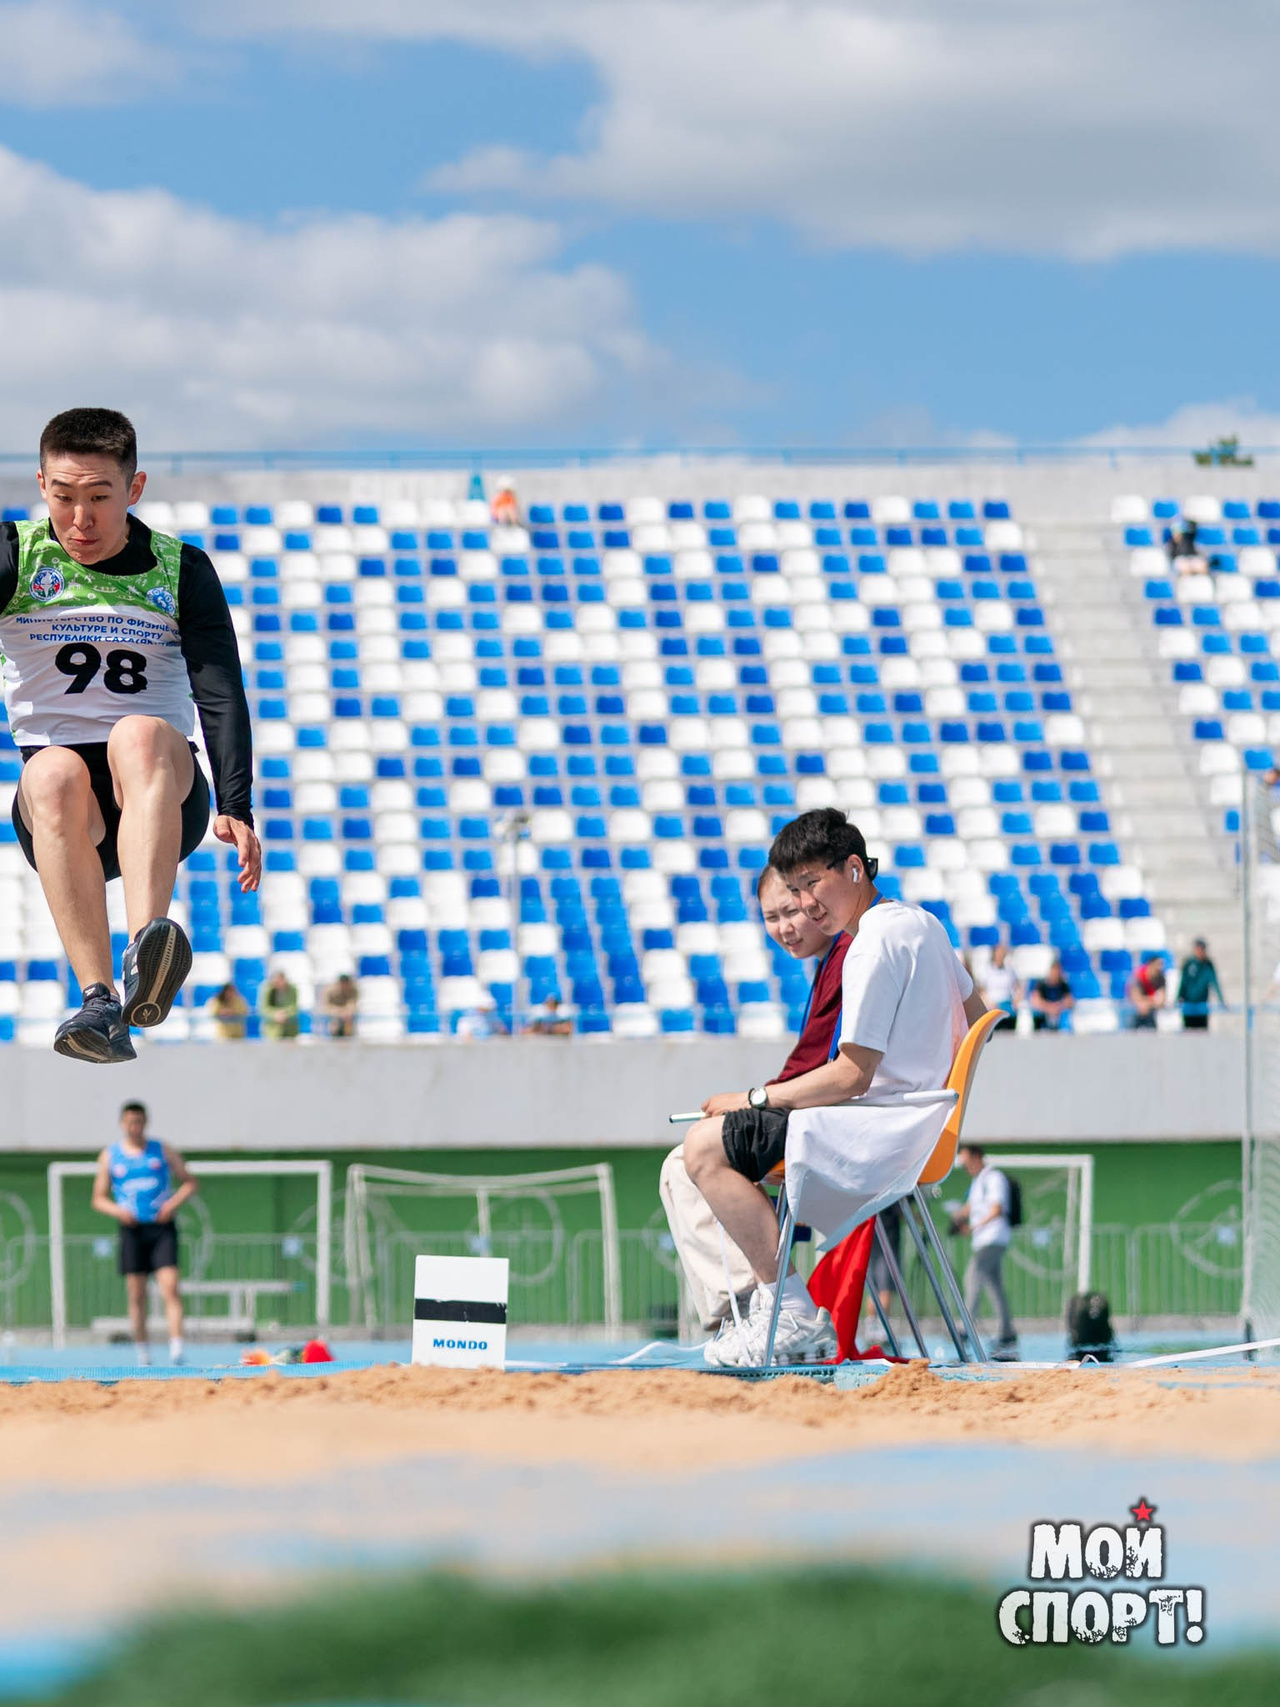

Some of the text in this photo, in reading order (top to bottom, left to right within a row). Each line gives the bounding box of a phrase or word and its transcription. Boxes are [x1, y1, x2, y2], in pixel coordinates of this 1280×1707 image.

[107, 616, 124, 624] ПО
[30, 633, 101, 642] РЕСПУБЛИКИ
[52, 624, 163, 640] КУЛЬТУРЕ И СПОРТУ
[55, 642, 148, 694] 98
[433, 1338, 488, 1350] MONDO
